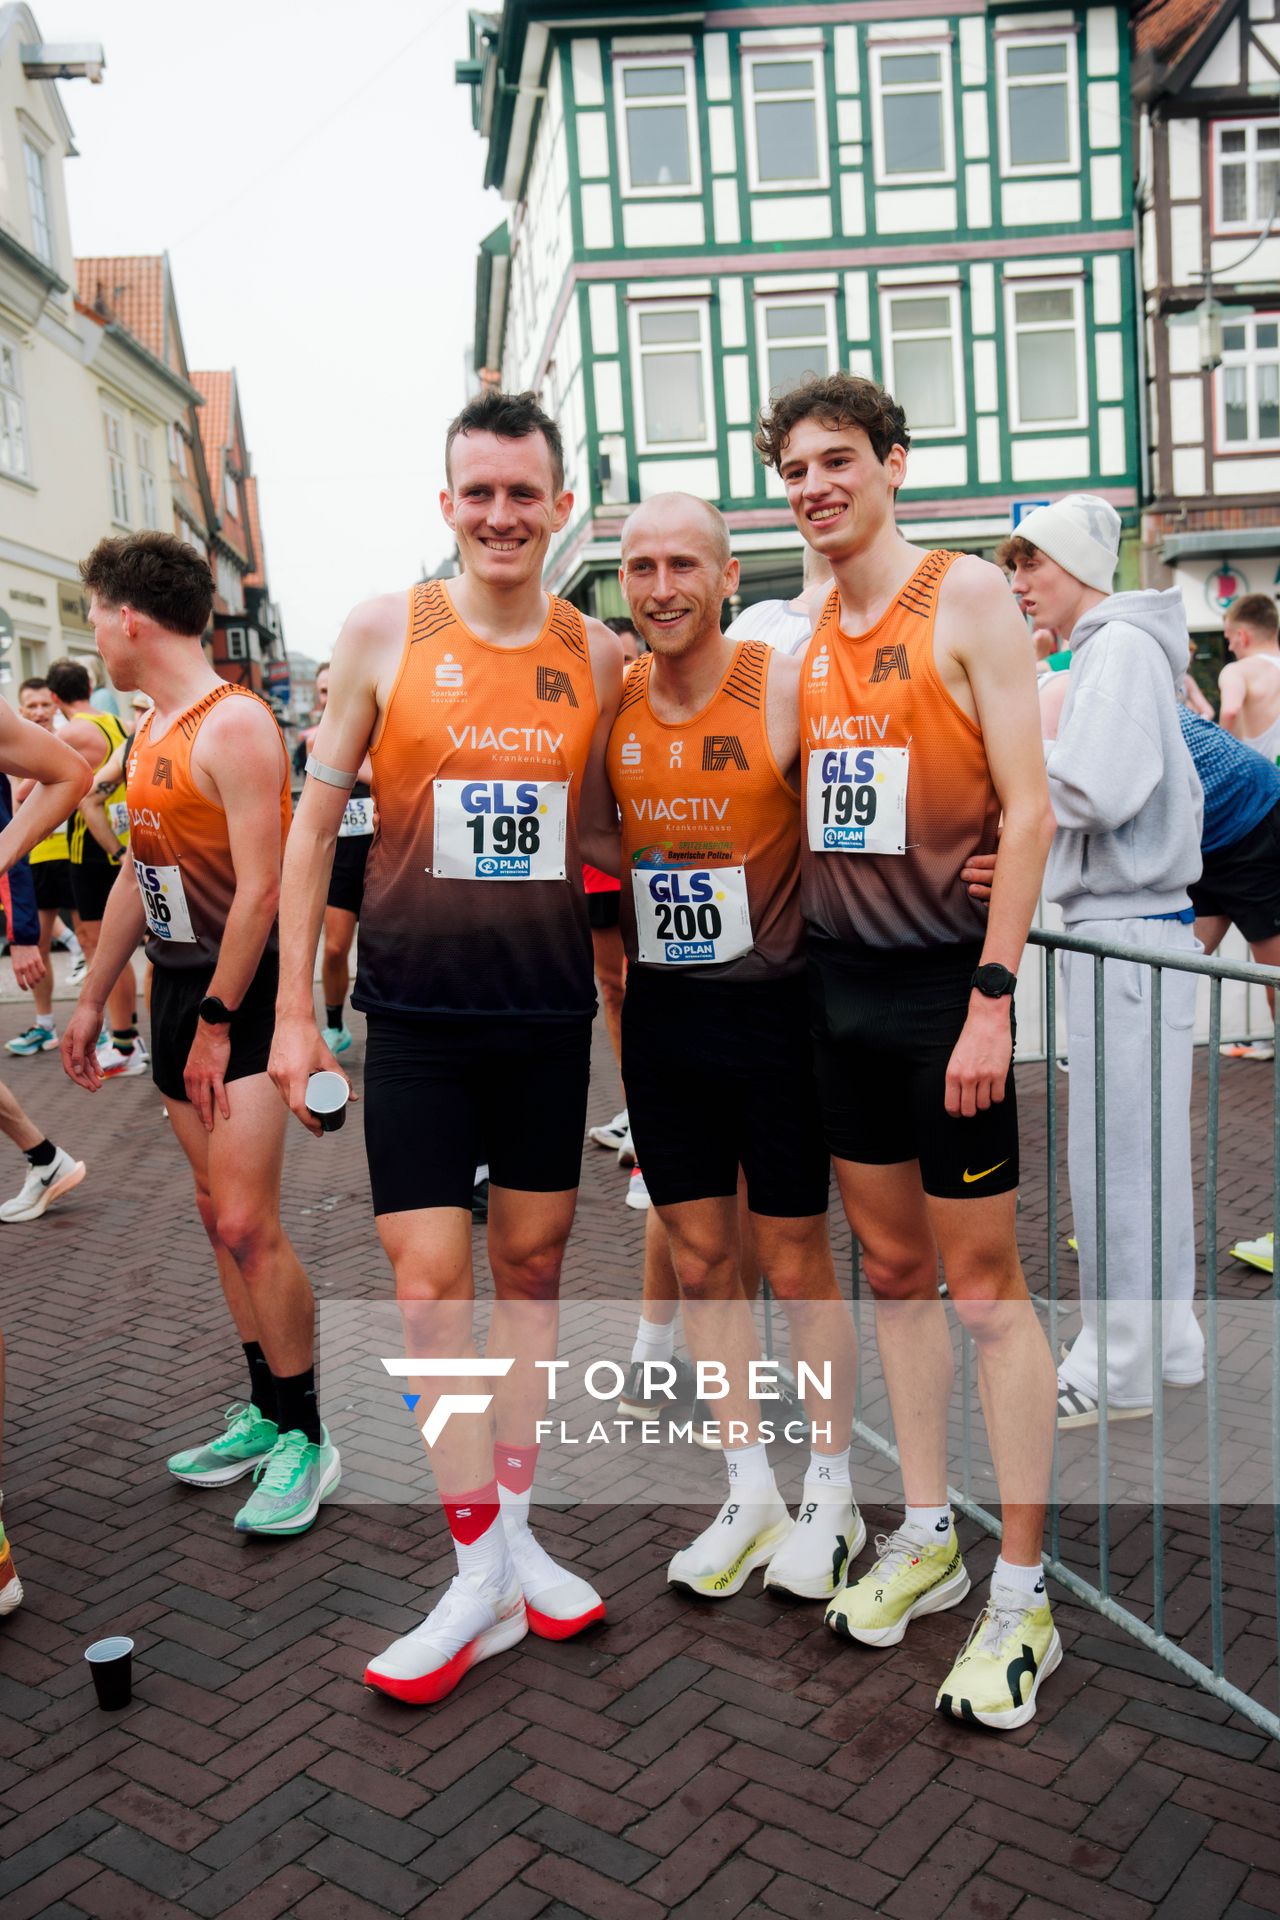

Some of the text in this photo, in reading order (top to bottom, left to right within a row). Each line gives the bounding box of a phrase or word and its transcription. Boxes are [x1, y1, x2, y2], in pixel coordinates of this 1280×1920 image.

[811, 714, 890, 741] VIACTIV
[447, 725, 564, 753] VIACTIV
[491, 753, 562, 766] Krankenkasse
[630, 797, 731, 821] VIACTIV
[821, 784, 877, 827] 199
[466, 816, 541, 856] 198
[665, 823, 732, 832] Krankenkasse
[837, 830, 863, 841] PLAN
[667, 850, 733, 861] Bayerische Polizei
[499, 859, 530, 871] PLAN
[654, 903, 722, 941] 200
[683, 944, 713, 955] PLAN
